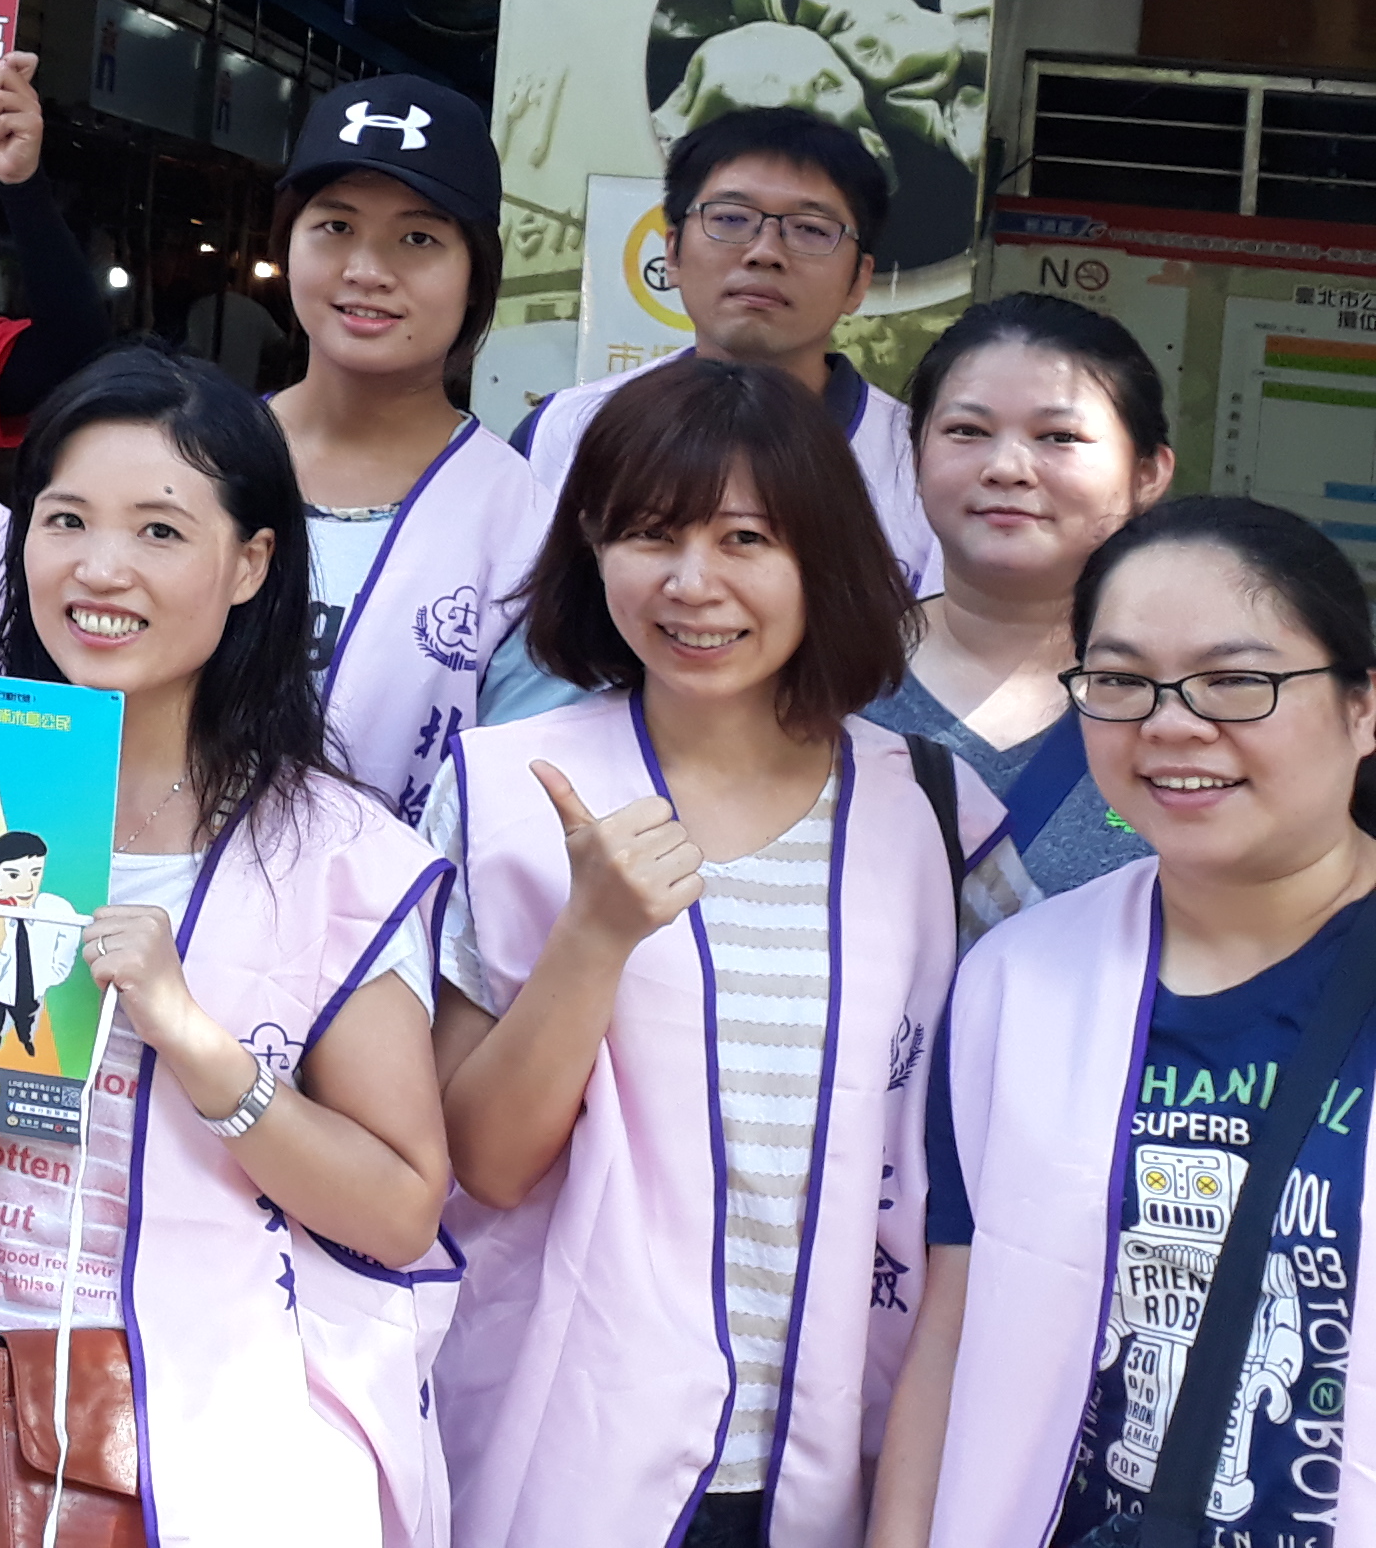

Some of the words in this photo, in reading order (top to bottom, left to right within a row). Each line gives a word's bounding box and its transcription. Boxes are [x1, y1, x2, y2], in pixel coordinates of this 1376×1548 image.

[1130, 1111, 1250, 1146] SUPERB
[1271, 1166, 1338, 1240] OOL
[1129, 1264, 1208, 1297] FRIEN
[1293, 1244, 1347, 1290] 93
[1146, 1293, 1203, 1333] ROB
[1127, 1346, 1156, 1376] 30
[1124, 1424, 1160, 1451] AMMO
[1111, 1453, 1141, 1478] POP
